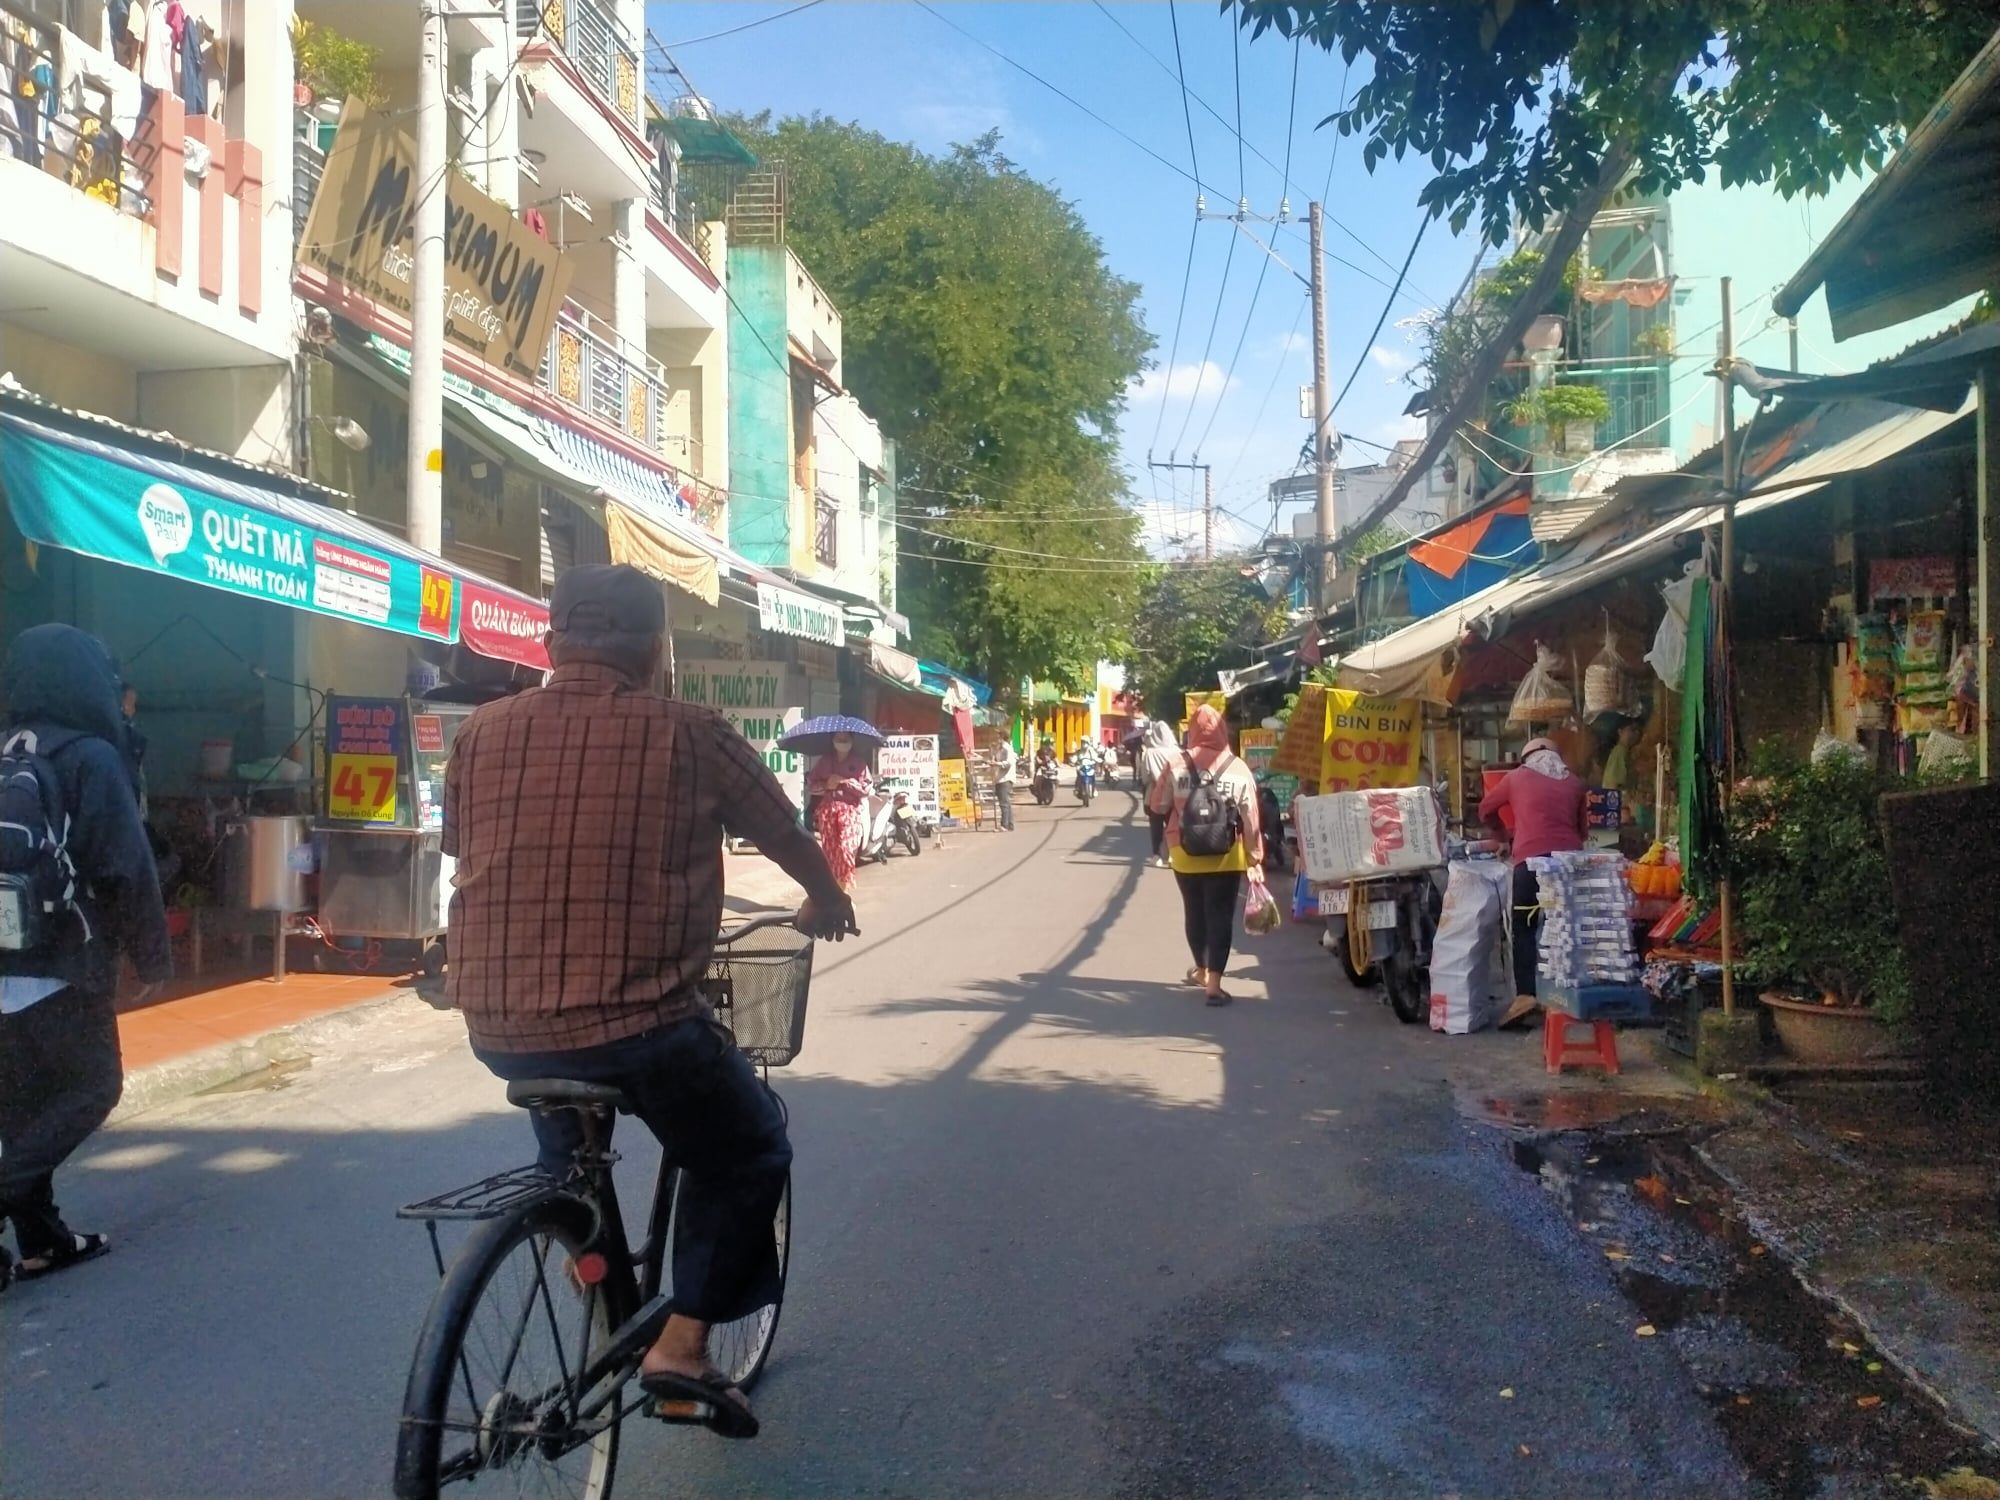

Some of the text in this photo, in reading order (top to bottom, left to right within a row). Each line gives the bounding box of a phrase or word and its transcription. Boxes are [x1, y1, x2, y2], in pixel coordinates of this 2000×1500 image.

[145, 502, 186, 528] Smart
[202, 509, 308, 569] QUÉT MÃ
[203, 553, 263, 591] THANH
[265, 572, 308, 602] TOÁN
[422, 575, 452, 620] 47
[471, 600, 510, 634] QUÁN
[510, 611, 535, 637] BÚN
[682, 665, 778, 708] NHÀ THUỐC TÂY
[743, 714, 785, 740] NHÀ
[1336, 714, 1412, 733] BIN BIN
[881, 737, 910, 748] QUÁN
[1330, 737, 1410, 767] CƠM
[333, 765, 395, 807] 47
[373, 809, 393, 820] Cung
